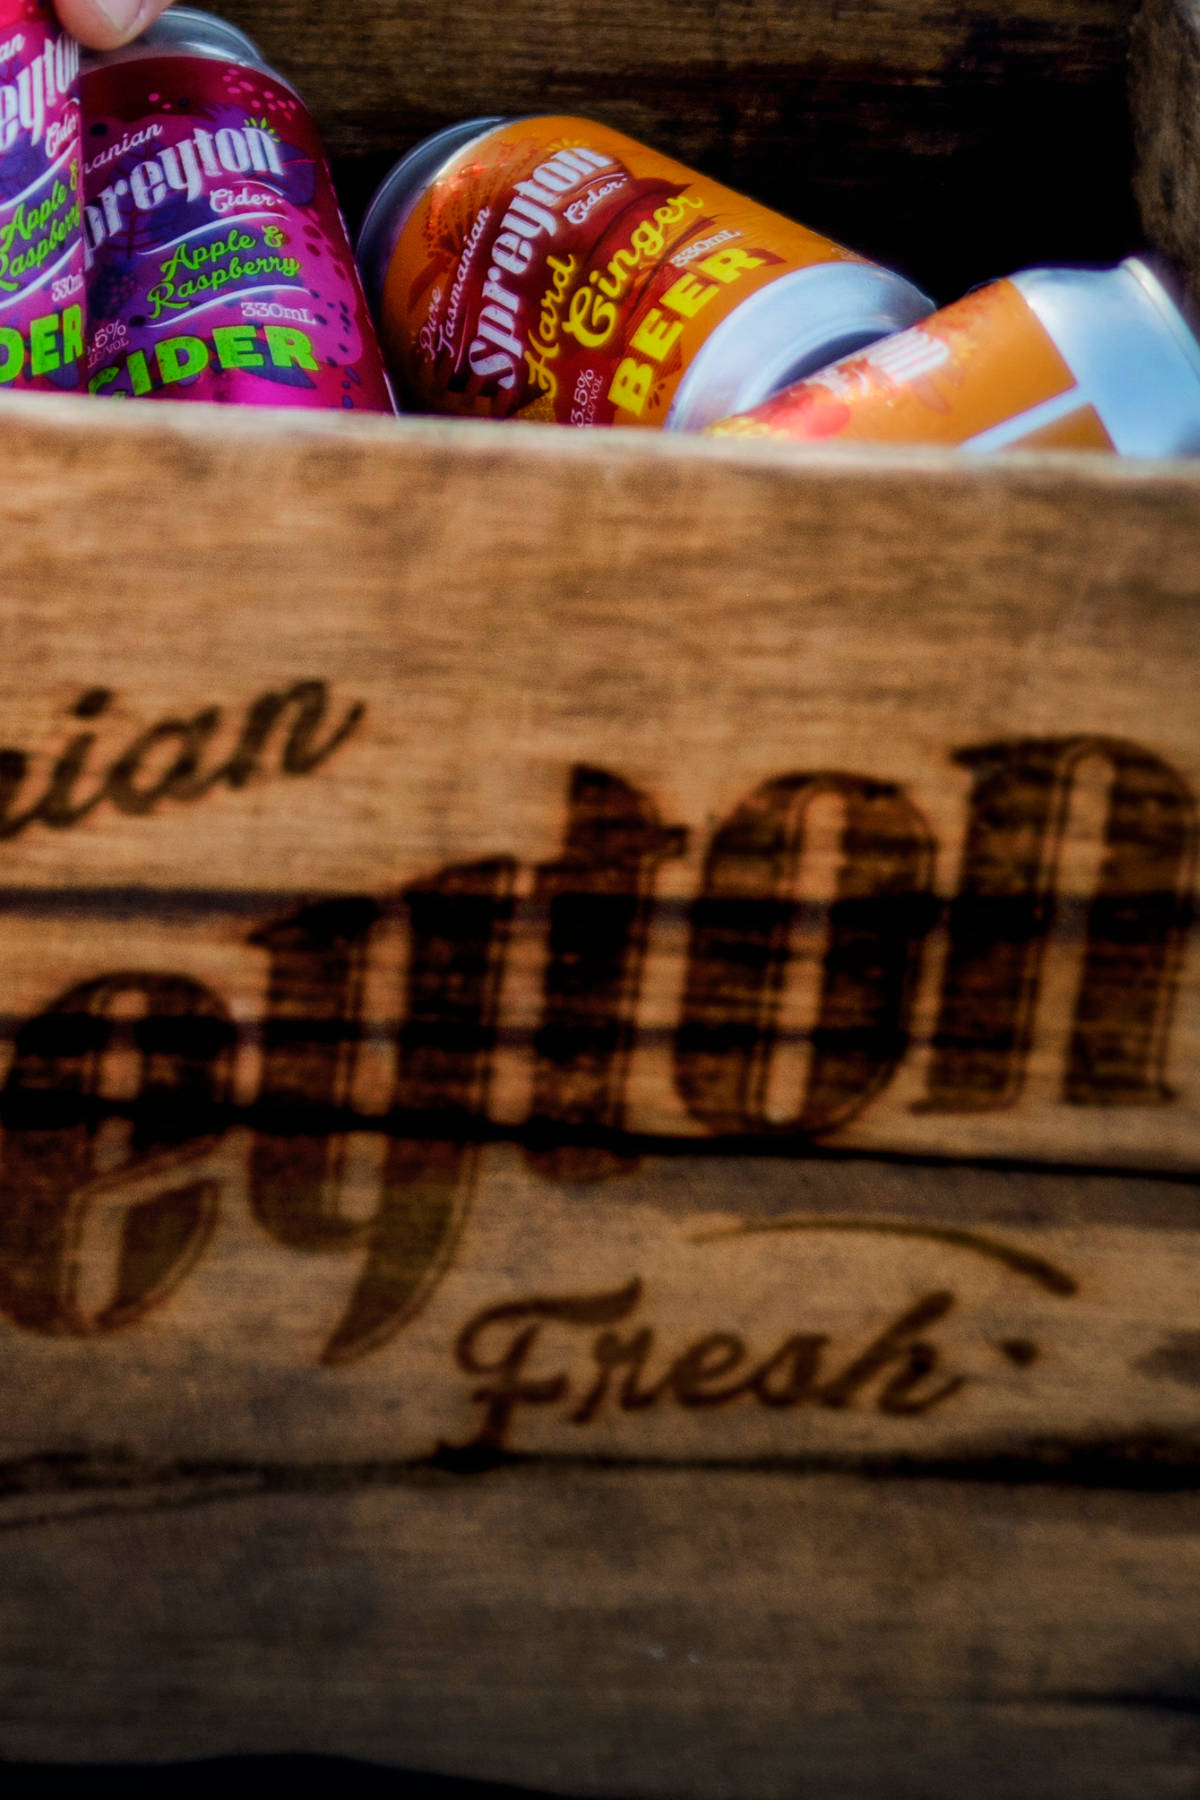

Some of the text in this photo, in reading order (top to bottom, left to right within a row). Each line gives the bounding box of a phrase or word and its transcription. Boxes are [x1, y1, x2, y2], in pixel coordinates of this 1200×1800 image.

[0, 179, 68, 252] Apple
[83, 126, 288, 272] preyton
[209, 186, 277, 214] Cider
[563, 179, 623, 226] Cider
[159, 225, 285, 281] Apple &
[437, 206, 490, 358] Tasmanian
[468, 146, 613, 391] Spreyton
[562, 194, 705, 349] Ginger
[670, 228, 742, 268] 330mL
[147, 254, 301, 320] Raspberry
[240, 301, 317, 326] 330mL
[420, 286, 441, 361] Pure
[88, 324, 320, 400] CIDER
[523, 252, 577, 400] Hard
[607, 247, 768, 417] BEER
[428, 1273, 968, 1473] Fresh
